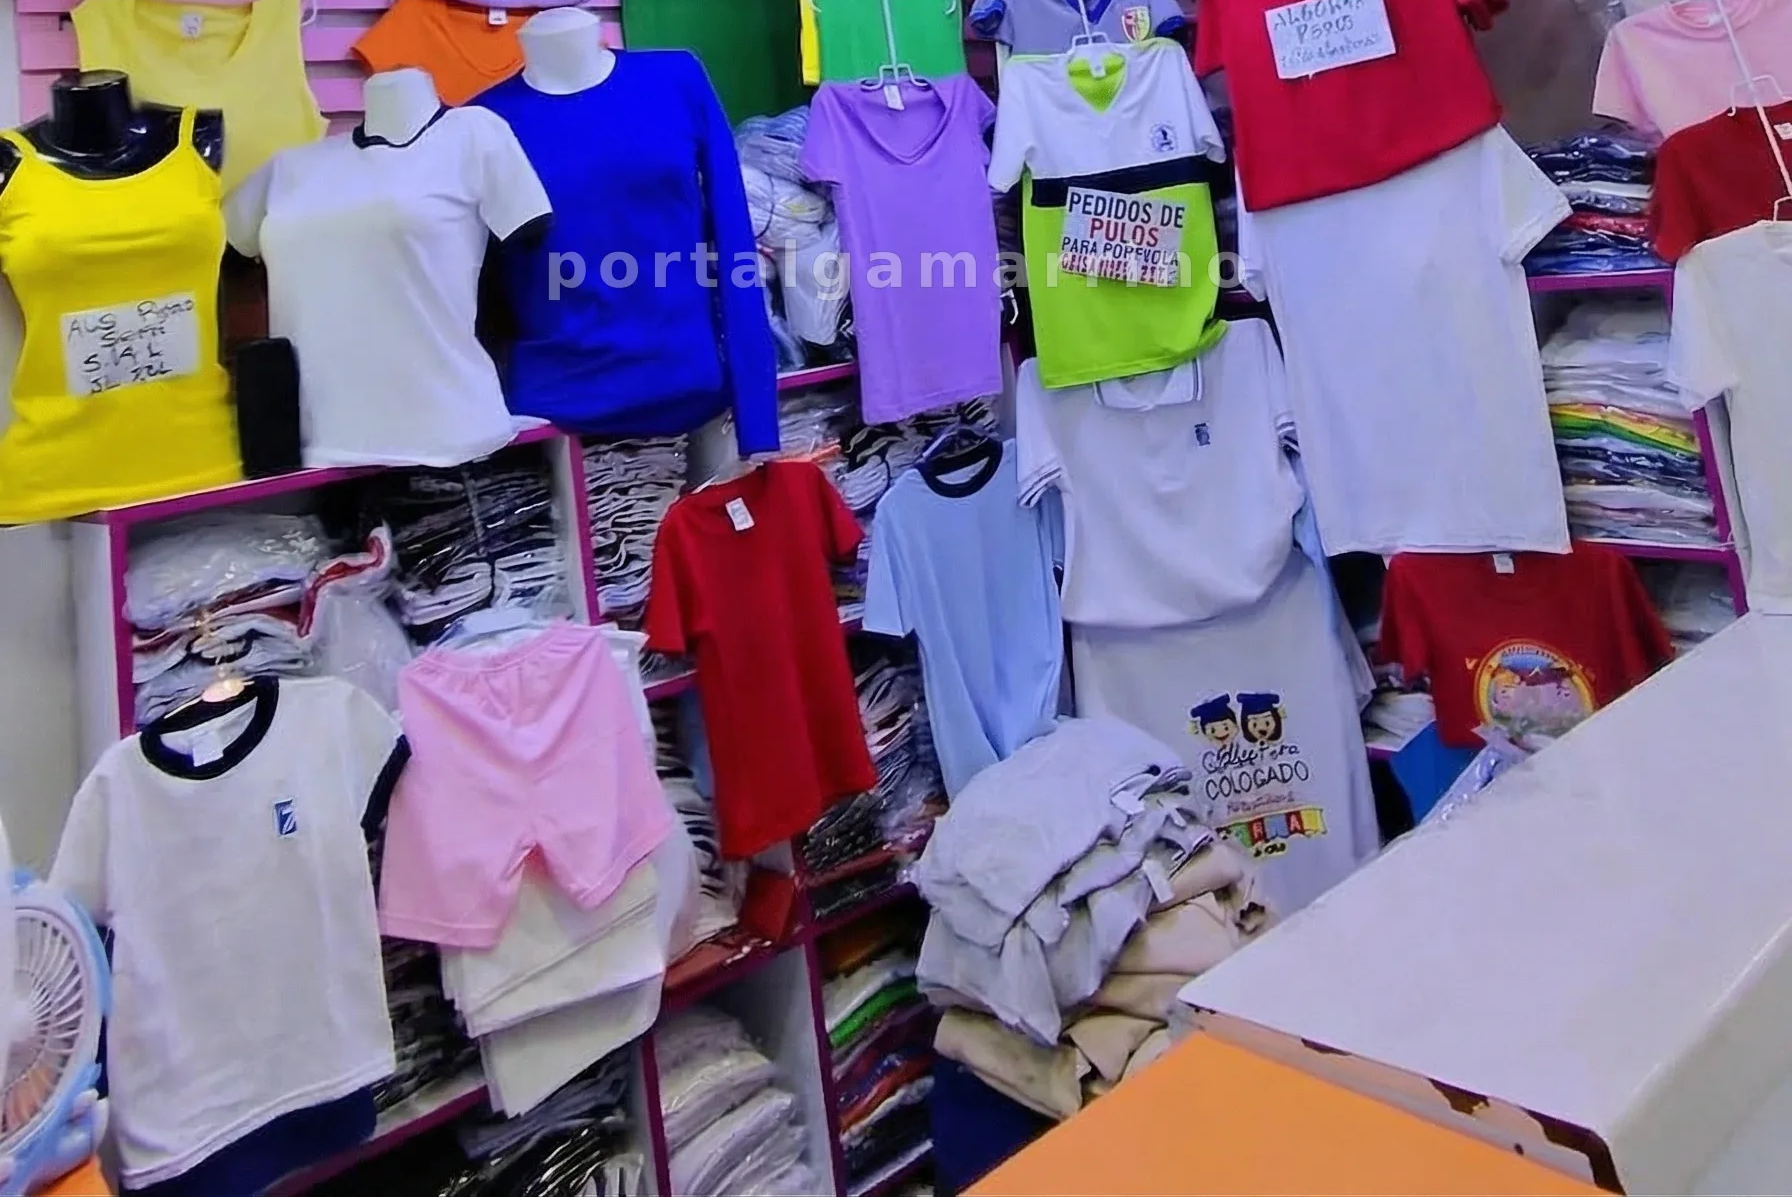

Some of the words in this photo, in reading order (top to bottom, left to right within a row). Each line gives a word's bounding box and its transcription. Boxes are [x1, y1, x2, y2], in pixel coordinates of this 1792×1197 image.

[1068, 191, 1153, 224] PEDIDOS
[1160, 204, 1185, 229] DE
[1061, 236, 1098, 255] PARA
[1089, 217, 1159, 248] PULOS
[1205, 760, 1310, 801] COLOGADO
